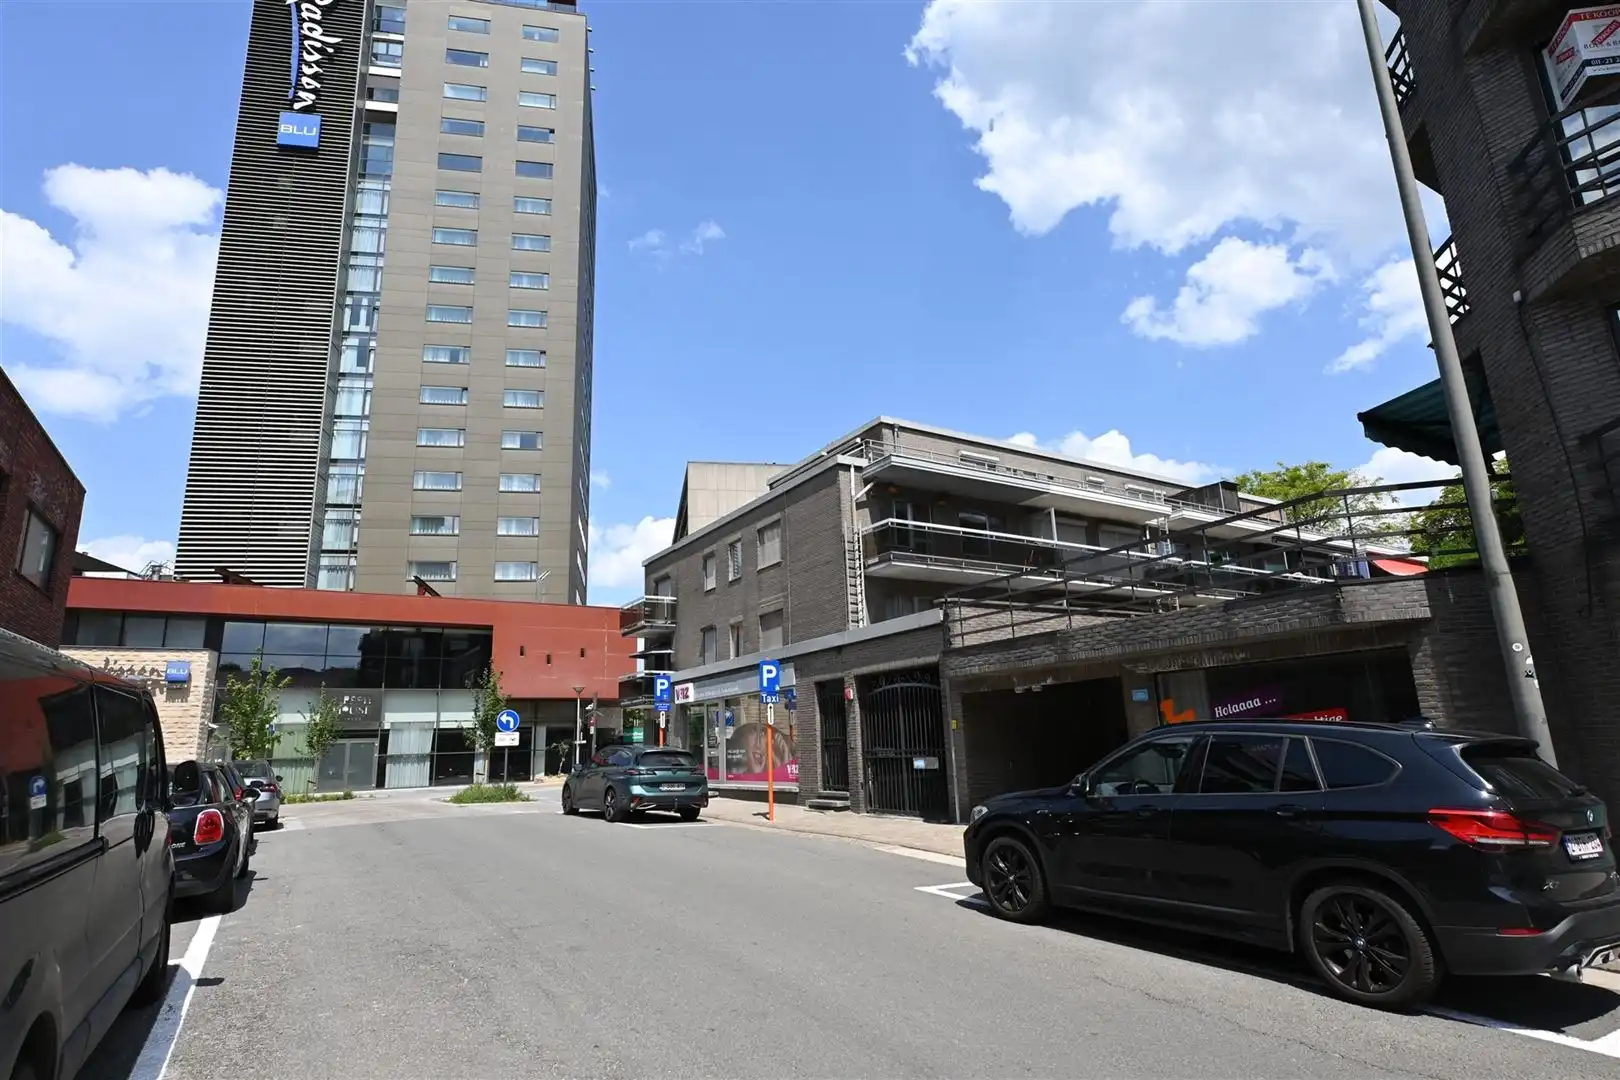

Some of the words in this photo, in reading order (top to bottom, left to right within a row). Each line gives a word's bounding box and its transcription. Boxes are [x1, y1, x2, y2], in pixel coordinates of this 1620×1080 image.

[285, 0, 343, 110] adisson
[280, 124, 316, 136] BLU
[762, 664, 777, 687] P
[656, 678, 669, 696] P
[761, 693, 780, 703] Taxi
[1214, 697, 1261, 718] Holaaaa
